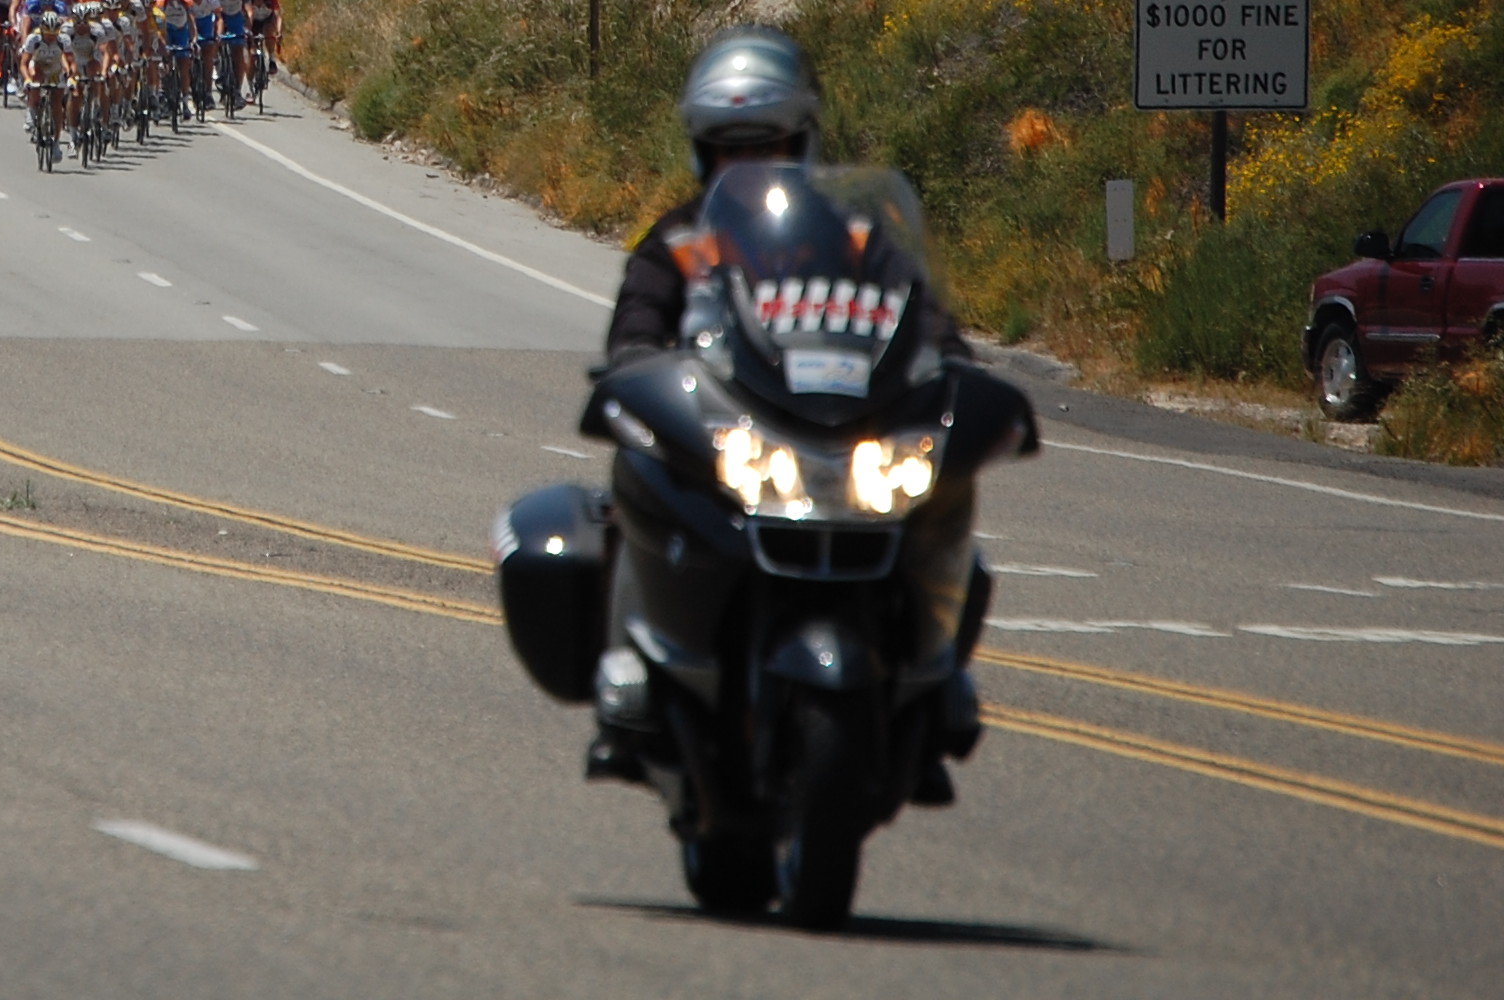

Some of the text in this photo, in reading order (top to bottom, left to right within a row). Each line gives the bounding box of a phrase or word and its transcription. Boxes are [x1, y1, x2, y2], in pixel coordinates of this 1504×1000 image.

[1146, 3, 1299, 28] $1000 FINE
[1198, 38, 1246, 61] FOR
[1156, 72, 1287, 96] LITTERING
